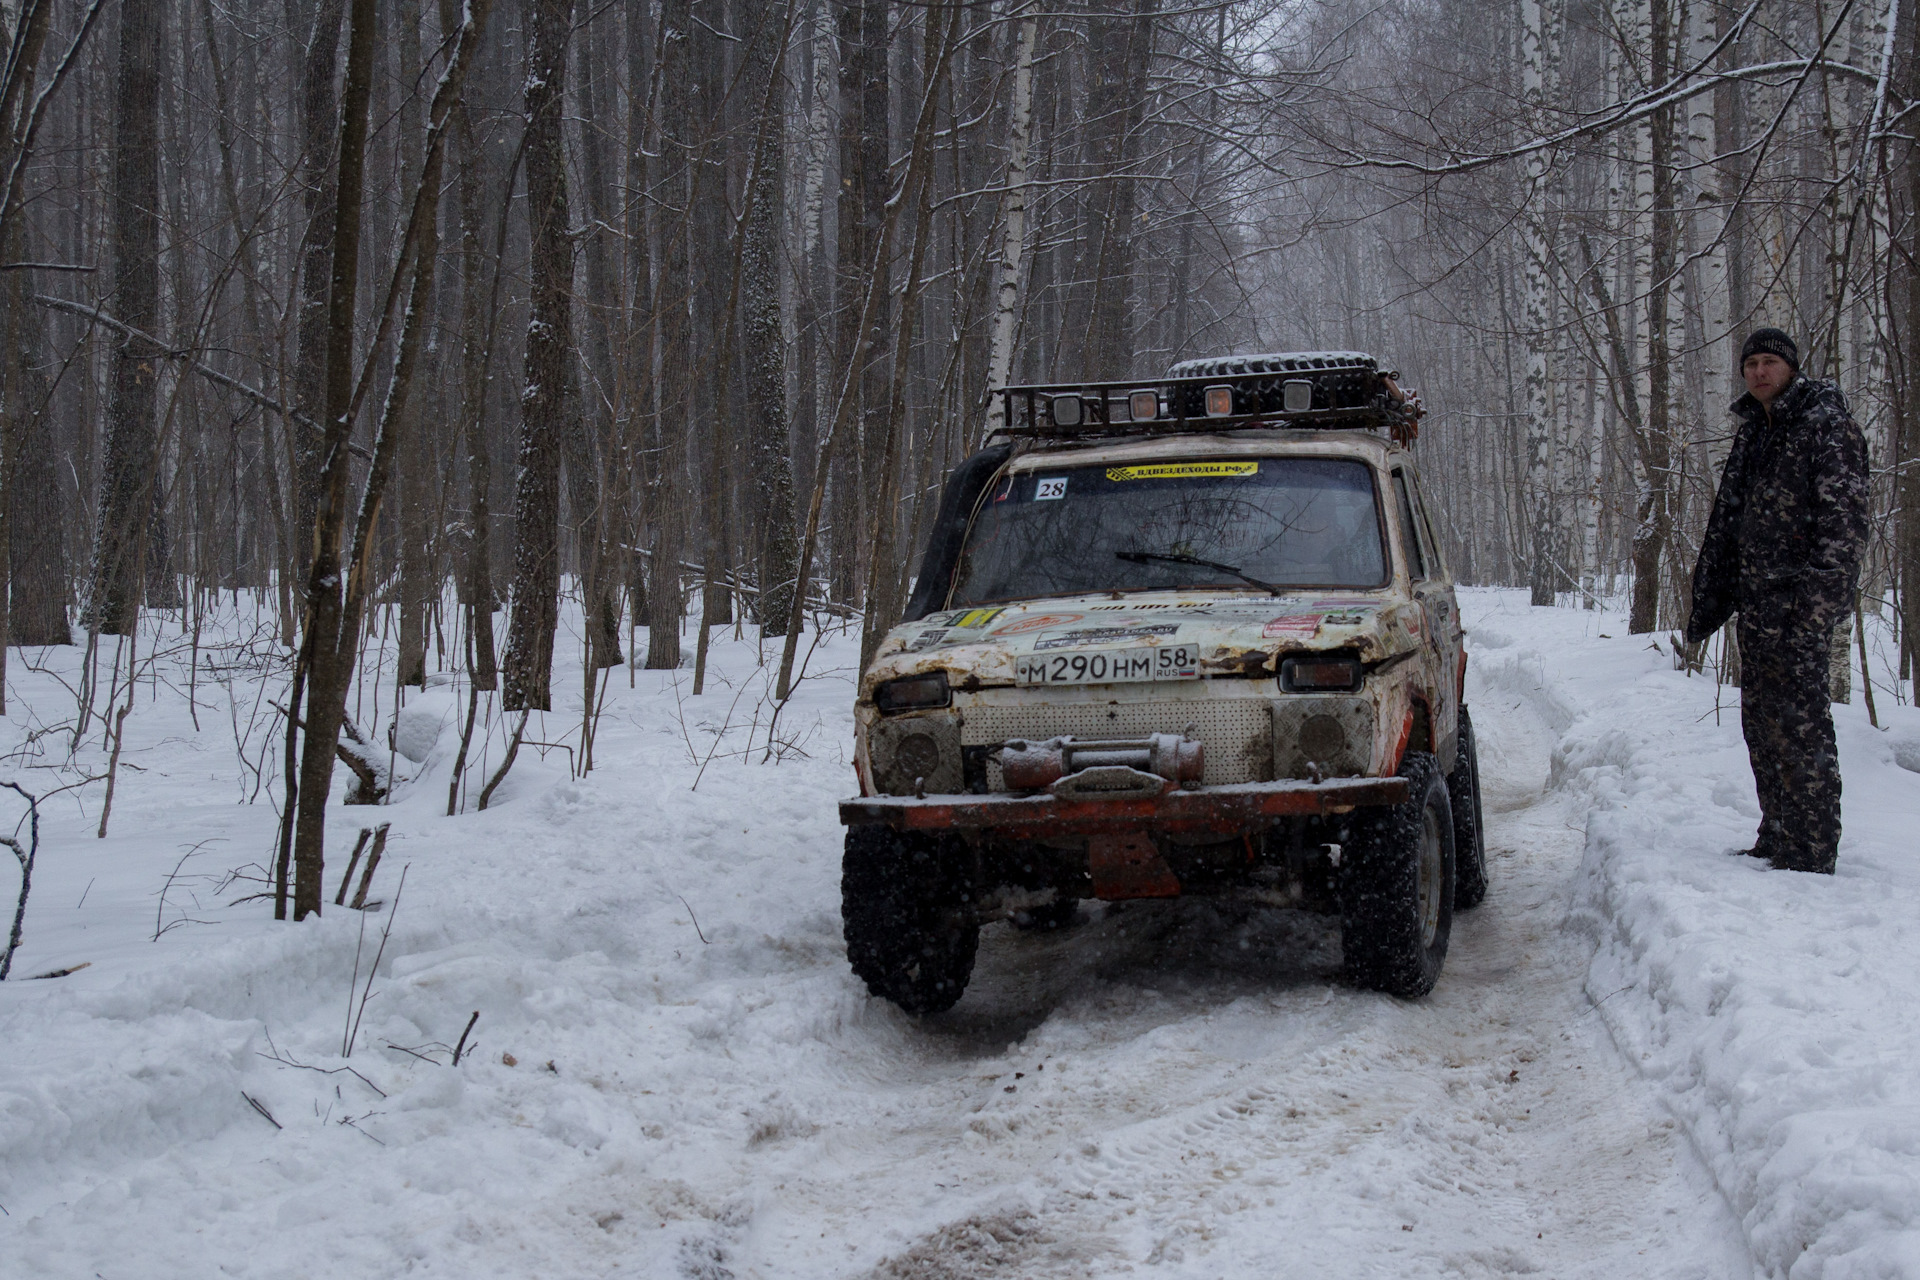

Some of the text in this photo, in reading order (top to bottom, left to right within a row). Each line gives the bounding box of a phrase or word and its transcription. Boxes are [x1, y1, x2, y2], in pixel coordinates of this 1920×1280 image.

[1038, 482, 1065, 497] 28
[1159, 648, 1188, 668] 58
[1156, 668, 1178, 677] RUS
